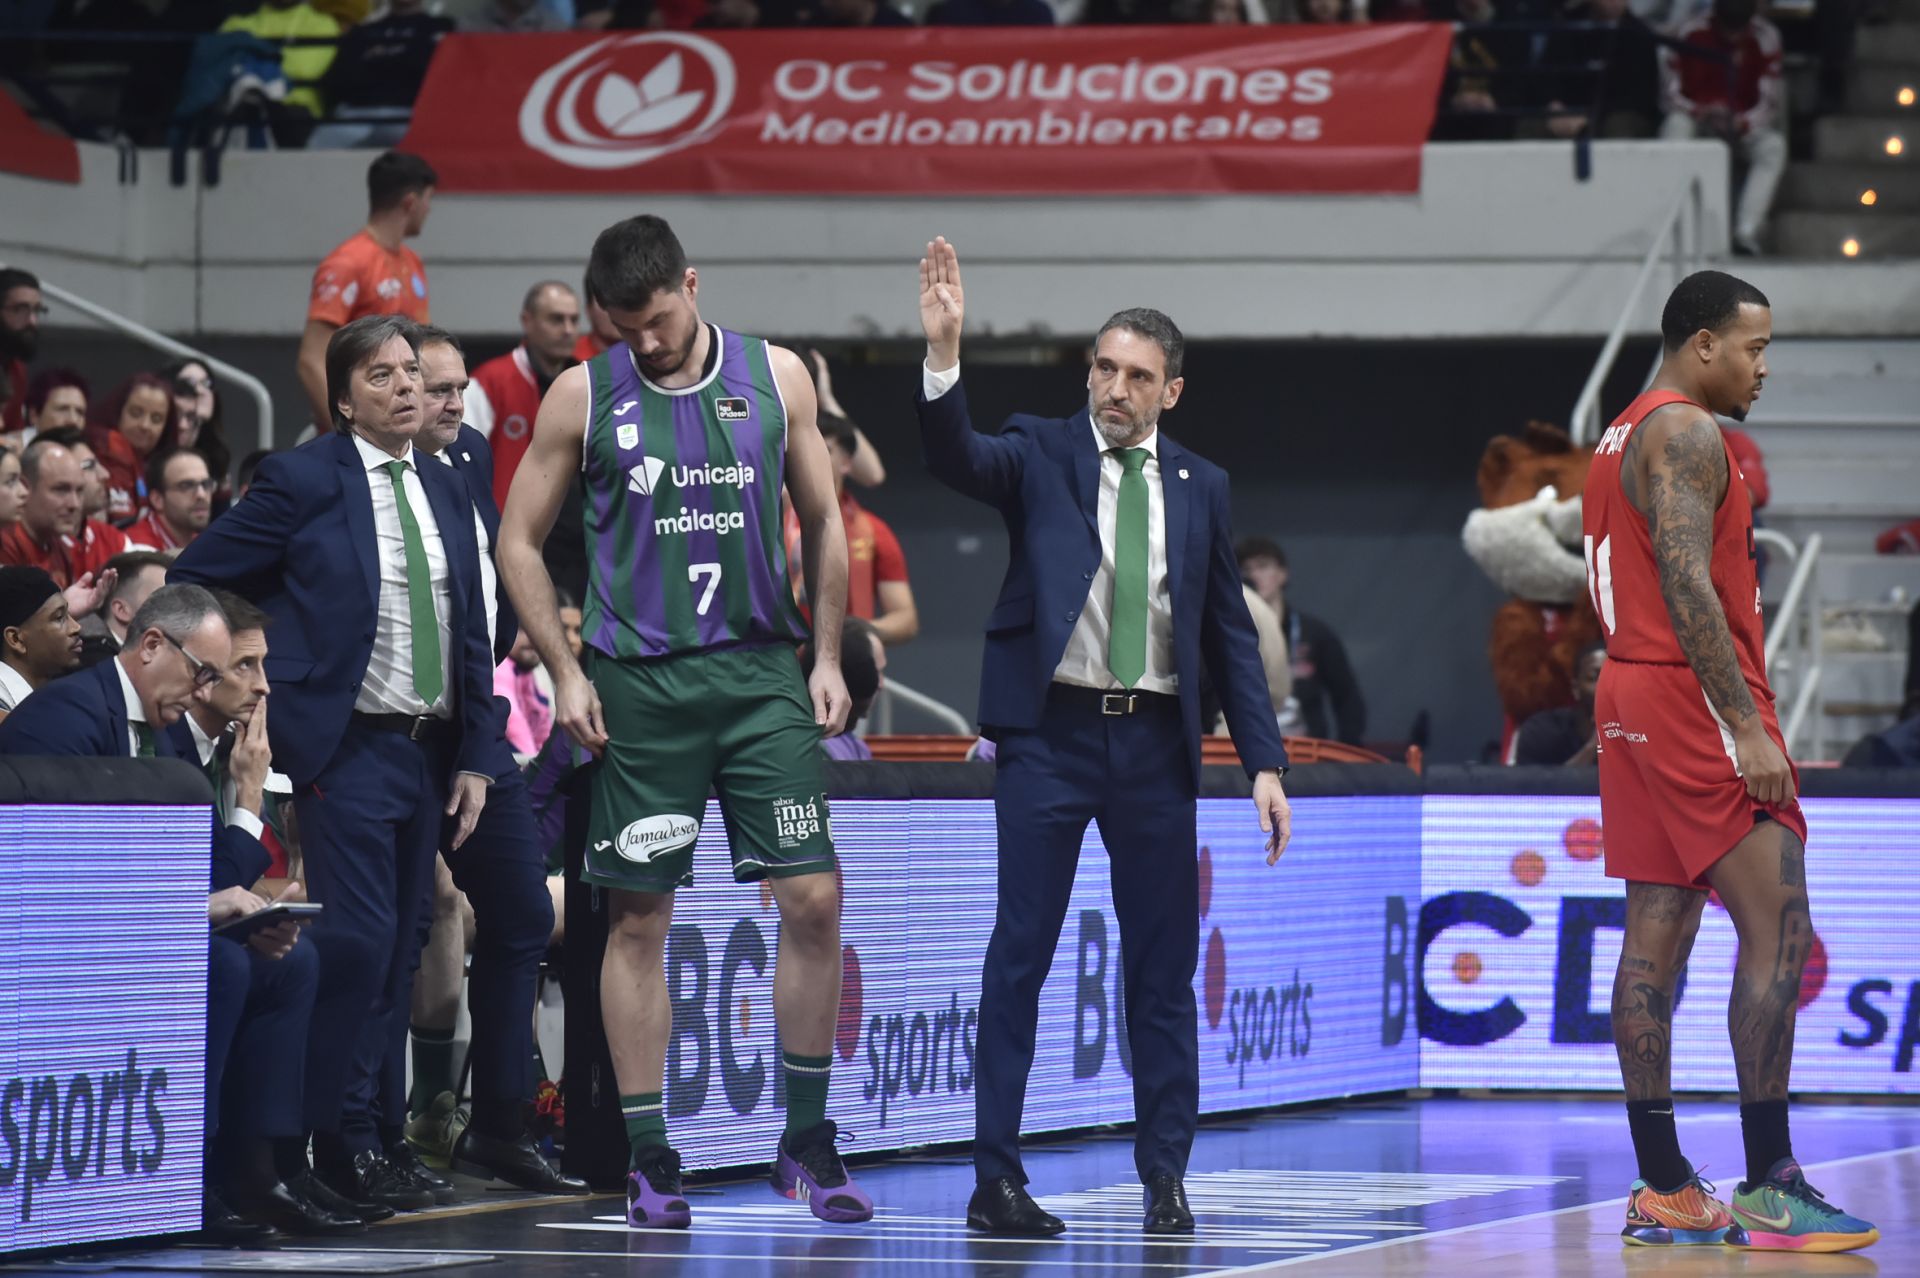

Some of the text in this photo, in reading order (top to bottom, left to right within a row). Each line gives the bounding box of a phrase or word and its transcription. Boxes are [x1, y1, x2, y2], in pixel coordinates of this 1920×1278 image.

[774, 58, 1333, 105] OC Soluciones
[761, 109, 1322, 146] Medioambientales
[671, 461, 755, 490] Unicaja
[654, 507, 745, 535] málaga
[688, 562, 722, 616] 7
[621, 819, 696, 852] famadesa
[665, 919, 787, 1117] BC
[1227, 967, 1313, 1090] sports
[863, 991, 976, 1129] sports
[0, 1048, 168, 1222] sports
